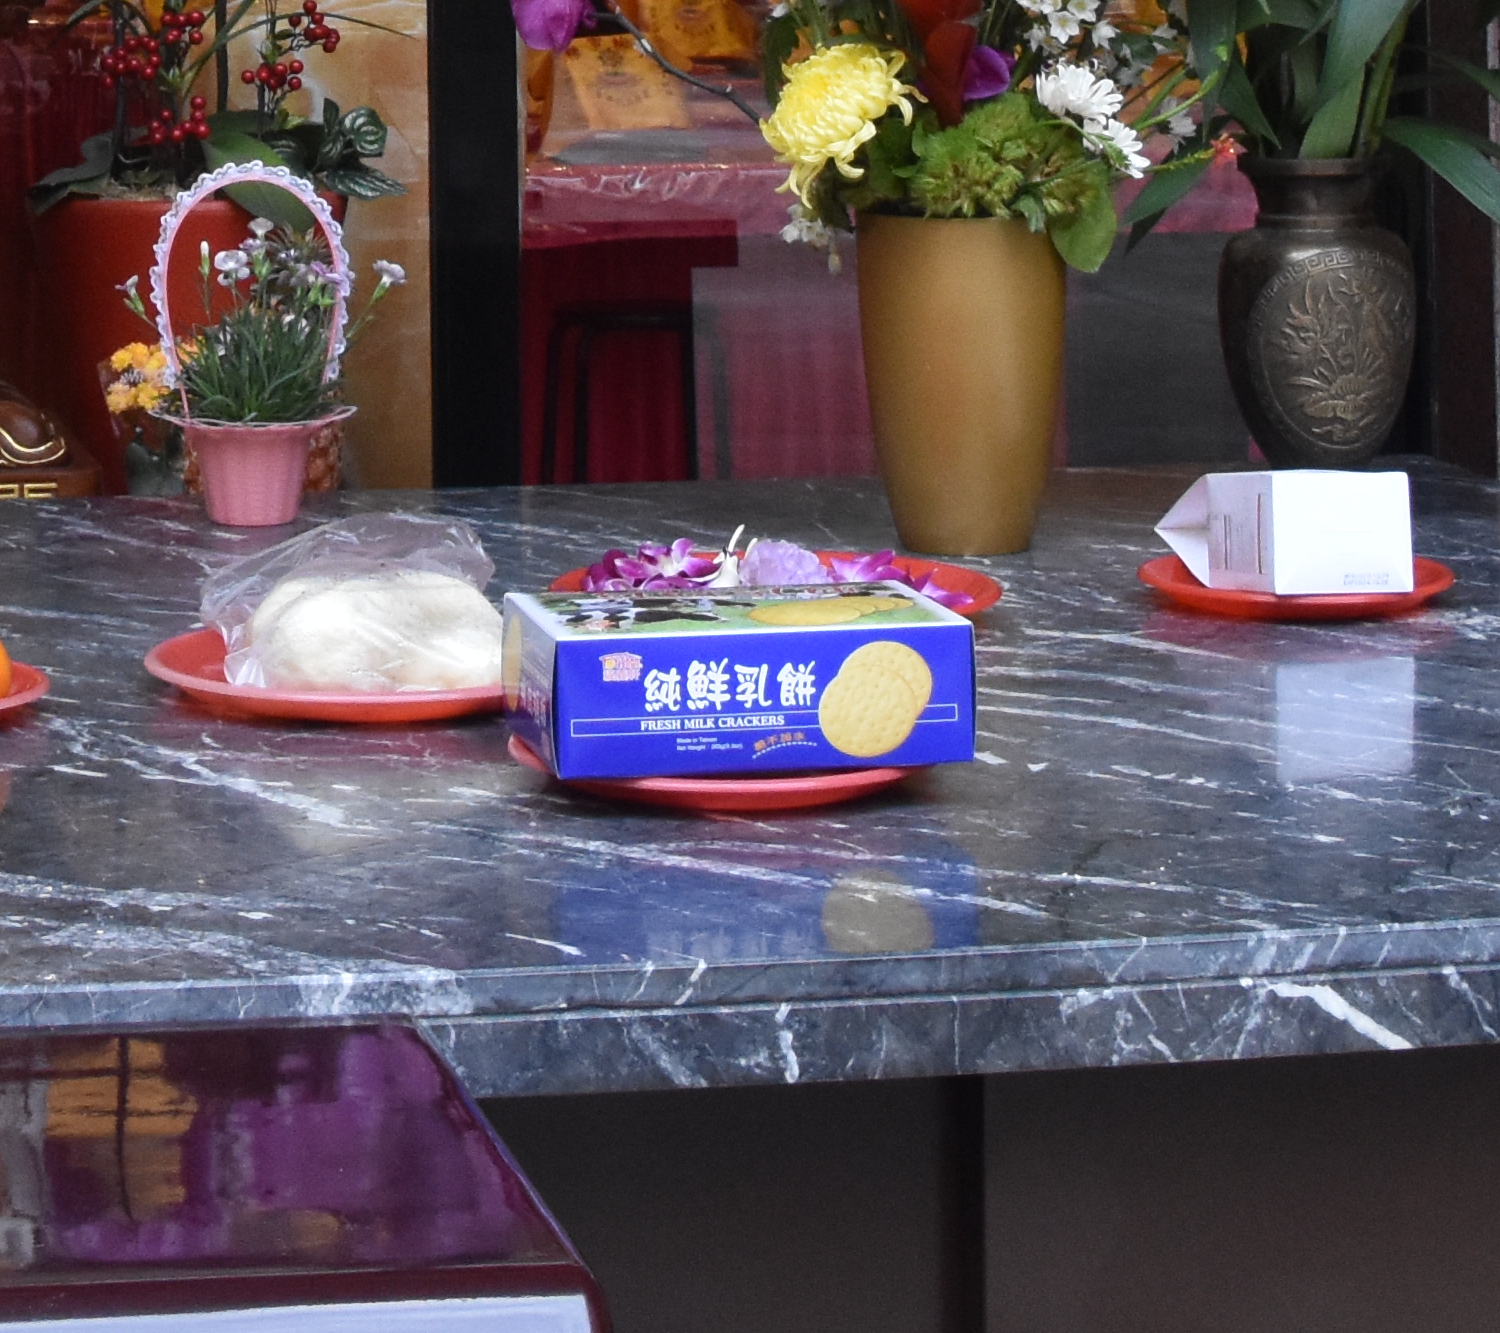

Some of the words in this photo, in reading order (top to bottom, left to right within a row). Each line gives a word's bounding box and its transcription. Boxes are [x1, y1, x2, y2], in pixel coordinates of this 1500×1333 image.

[643, 657, 816, 712] 純鮮乳餅
[640, 719, 681, 731] FRESH
[684, 718, 716, 730] MILK
[718, 715, 785, 729] CRACKERS
